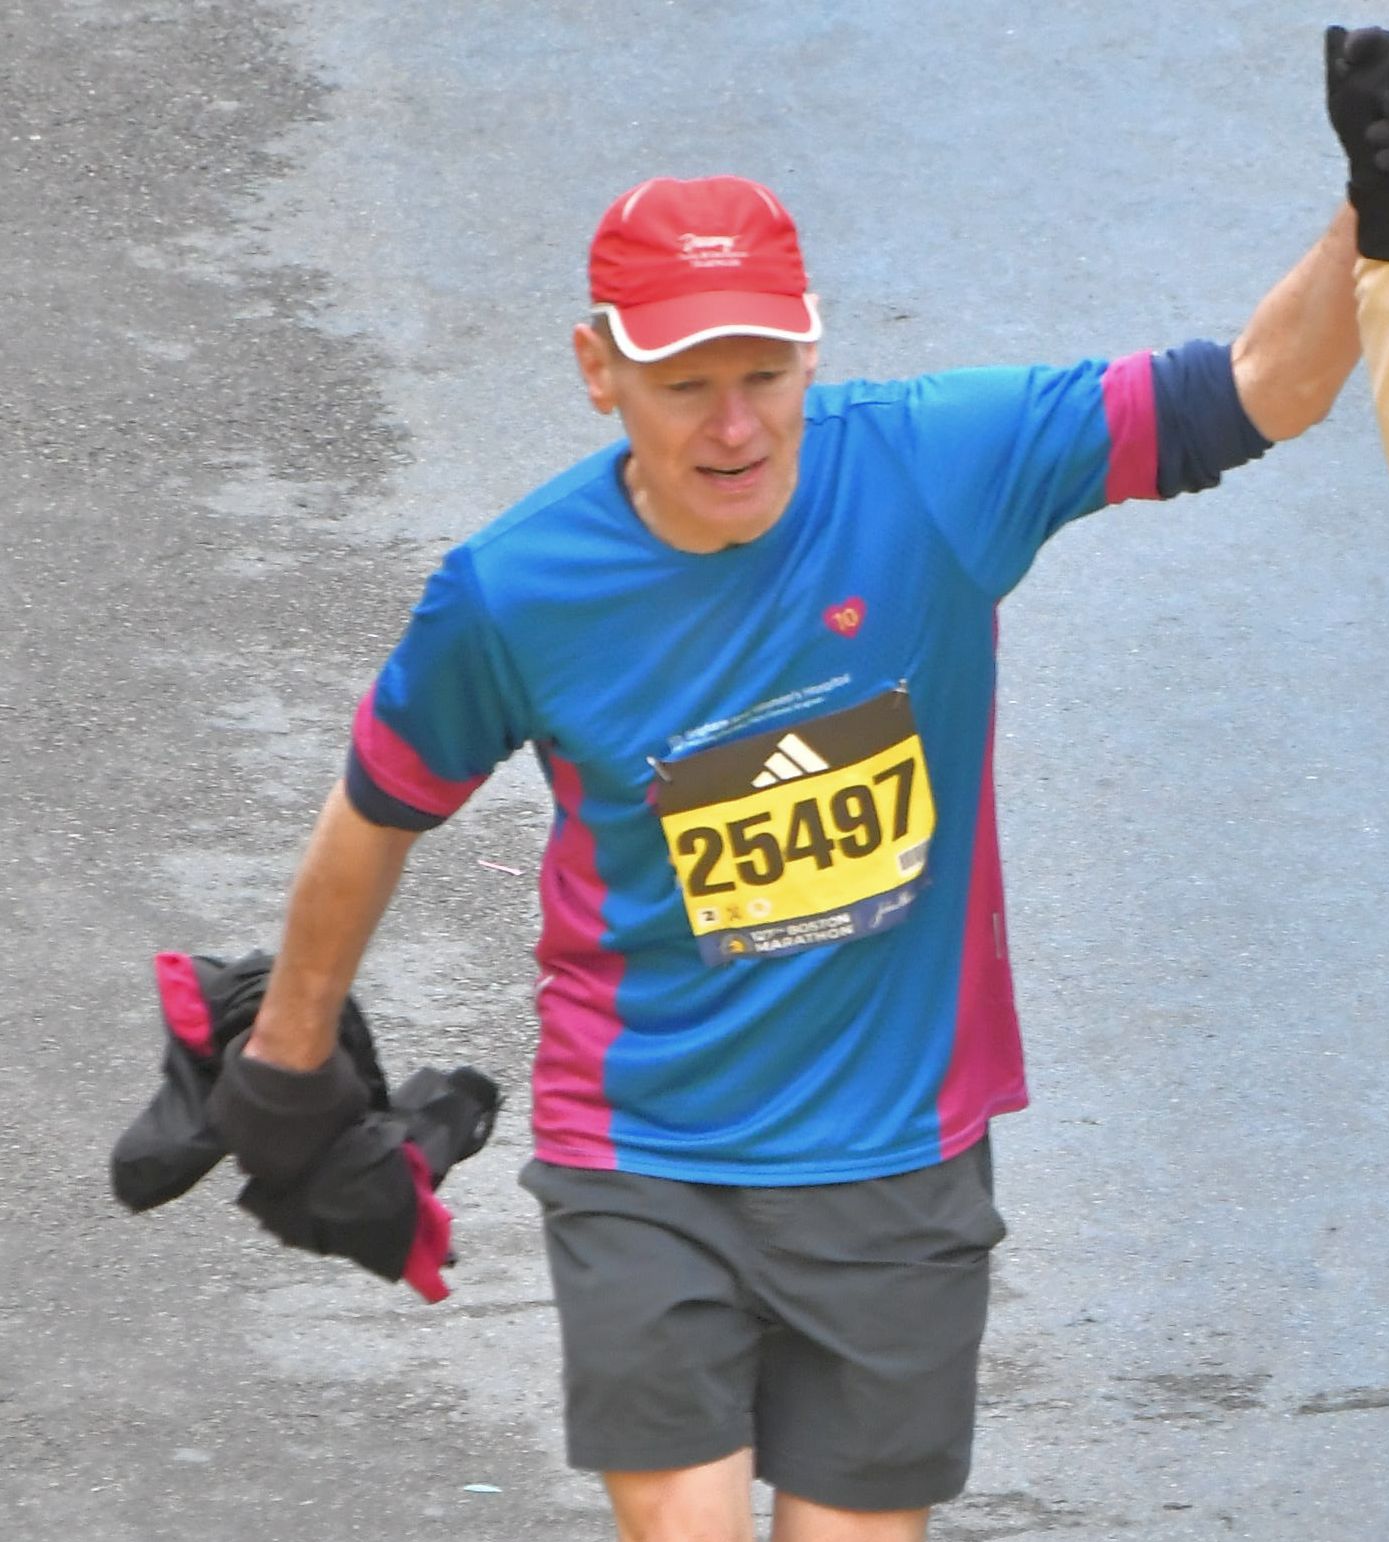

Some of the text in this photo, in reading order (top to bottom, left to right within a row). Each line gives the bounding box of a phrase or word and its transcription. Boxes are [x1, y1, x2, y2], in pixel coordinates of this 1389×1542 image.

[832, 608, 859, 631] 10
[676, 757, 915, 897] 25497
[786, 912, 850, 934] BOSTON
[754, 925, 854, 951] MARATHON
